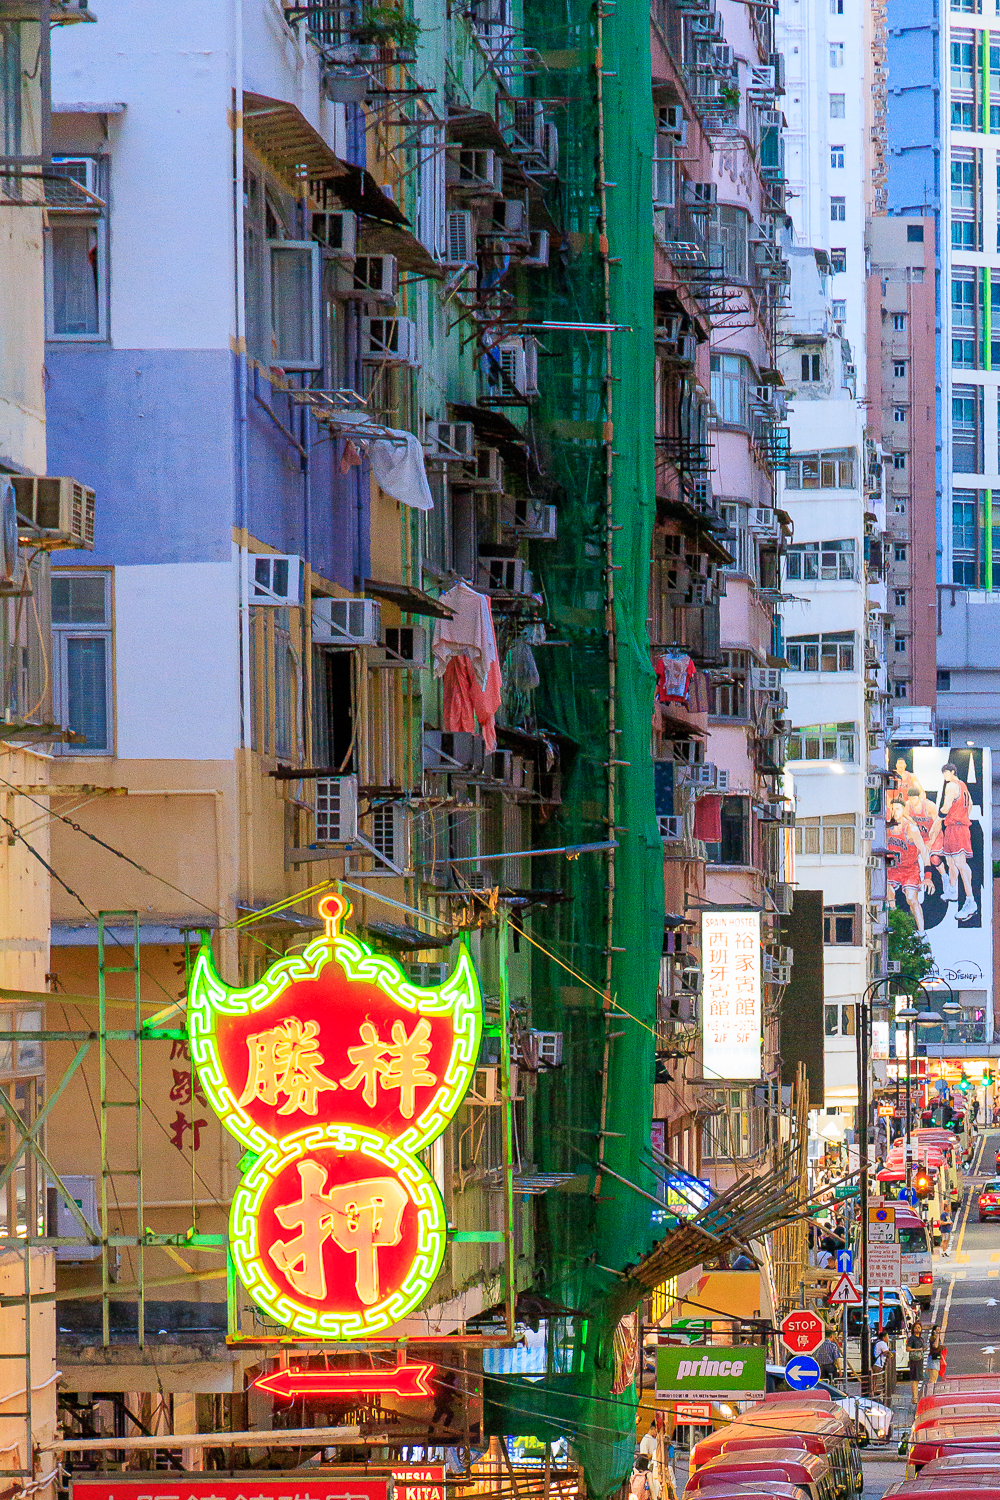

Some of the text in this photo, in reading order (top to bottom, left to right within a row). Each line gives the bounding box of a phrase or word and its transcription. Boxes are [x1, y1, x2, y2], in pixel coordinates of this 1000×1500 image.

[705, 917, 757, 928] SPAIN HOSTEL
[708, 931, 730, 1016] 西班牙賓館
[734, 931, 756, 1016] 裕家賓館
[714, 1033, 751, 1043] 2/F 5/F
[238, 1014, 438, 1119] 勝祥
[268, 1159, 411, 1305] 押
[788, 1321, 817, 1331] STOP
[797, 1334, 809, 1347] 停
[676, 1355, 744, 1380] prince
[405, 1487, 441, 1500] KITA
